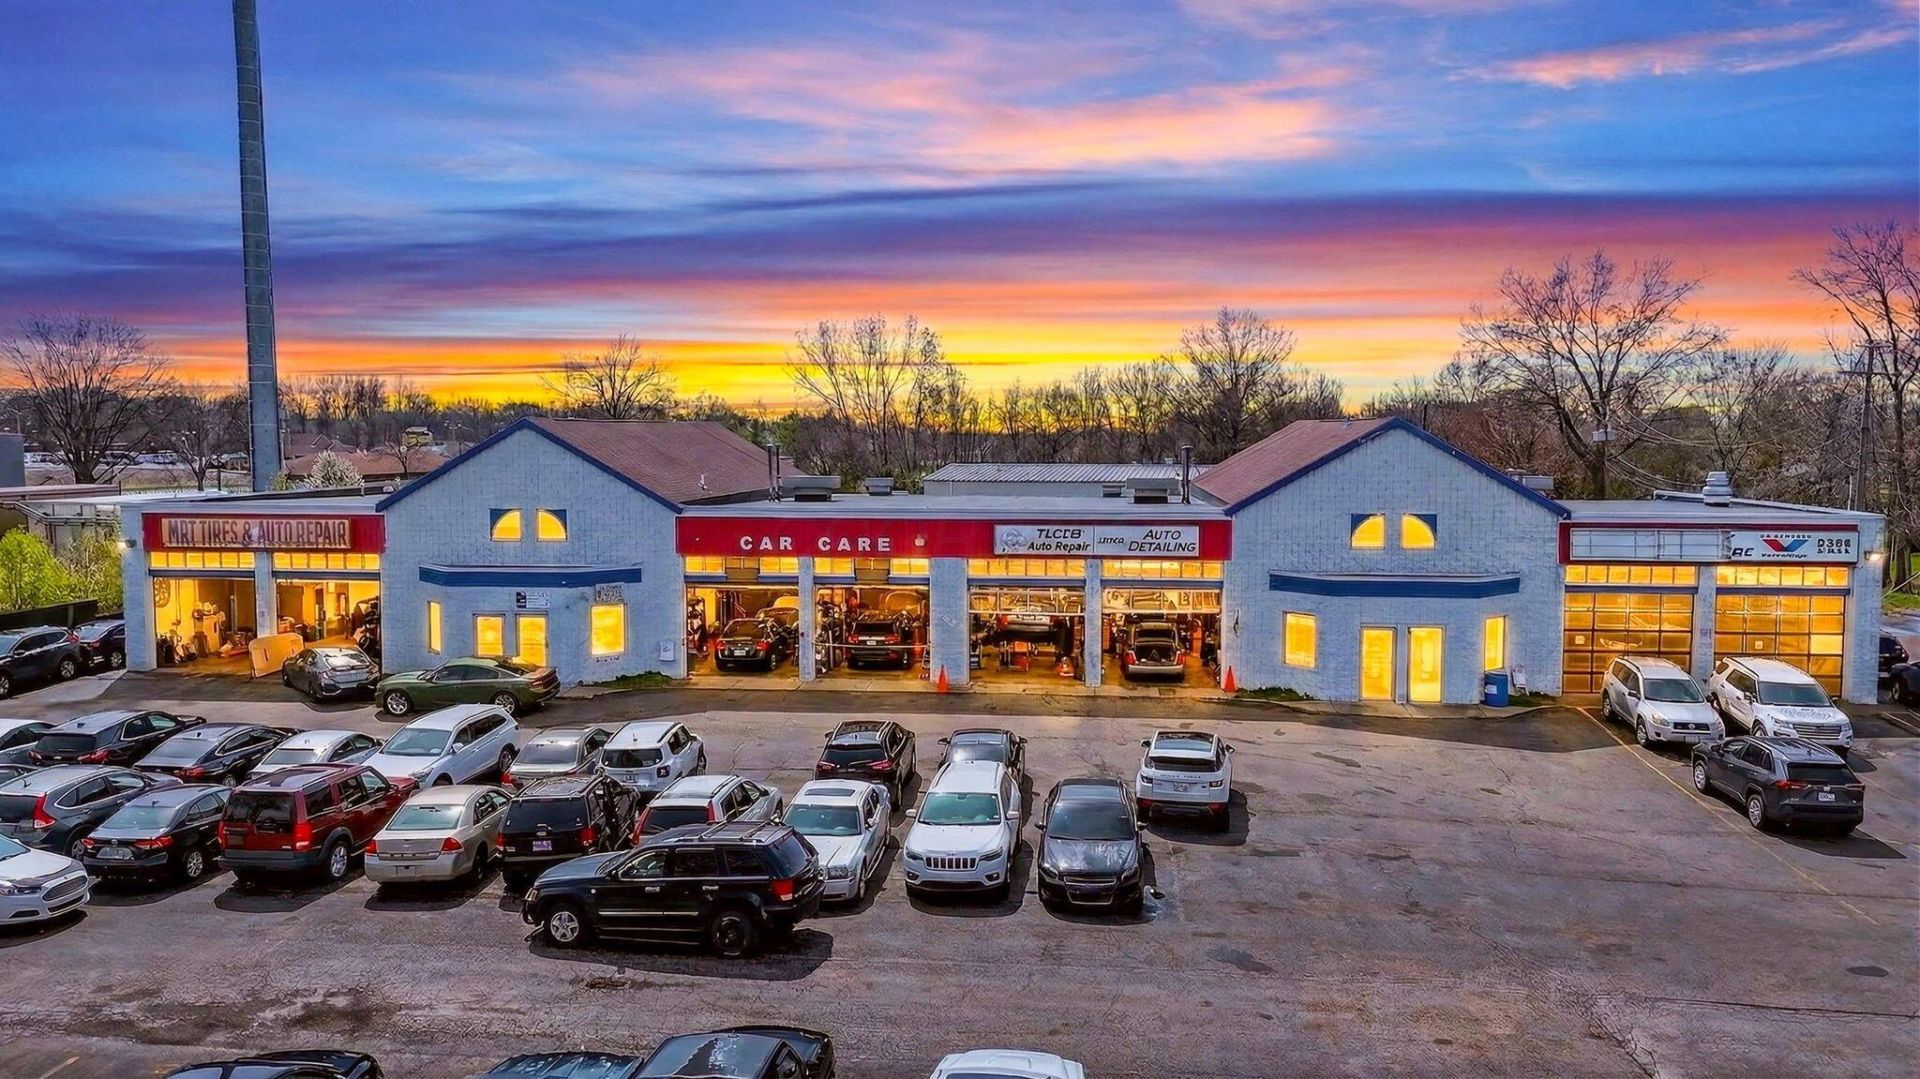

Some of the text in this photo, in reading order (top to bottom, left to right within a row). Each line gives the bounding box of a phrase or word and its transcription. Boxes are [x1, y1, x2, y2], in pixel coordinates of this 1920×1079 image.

[167, 520, 348, 547] MRT TIRES & AUTO REPAIR
[1142, 529, 1182, 540] AUTO
[739, 535, 891, 552] CAR CARE
[1027, 541, 1091, 553] Auto Repair
[1128, 541, 1196, 552] DETAILING
